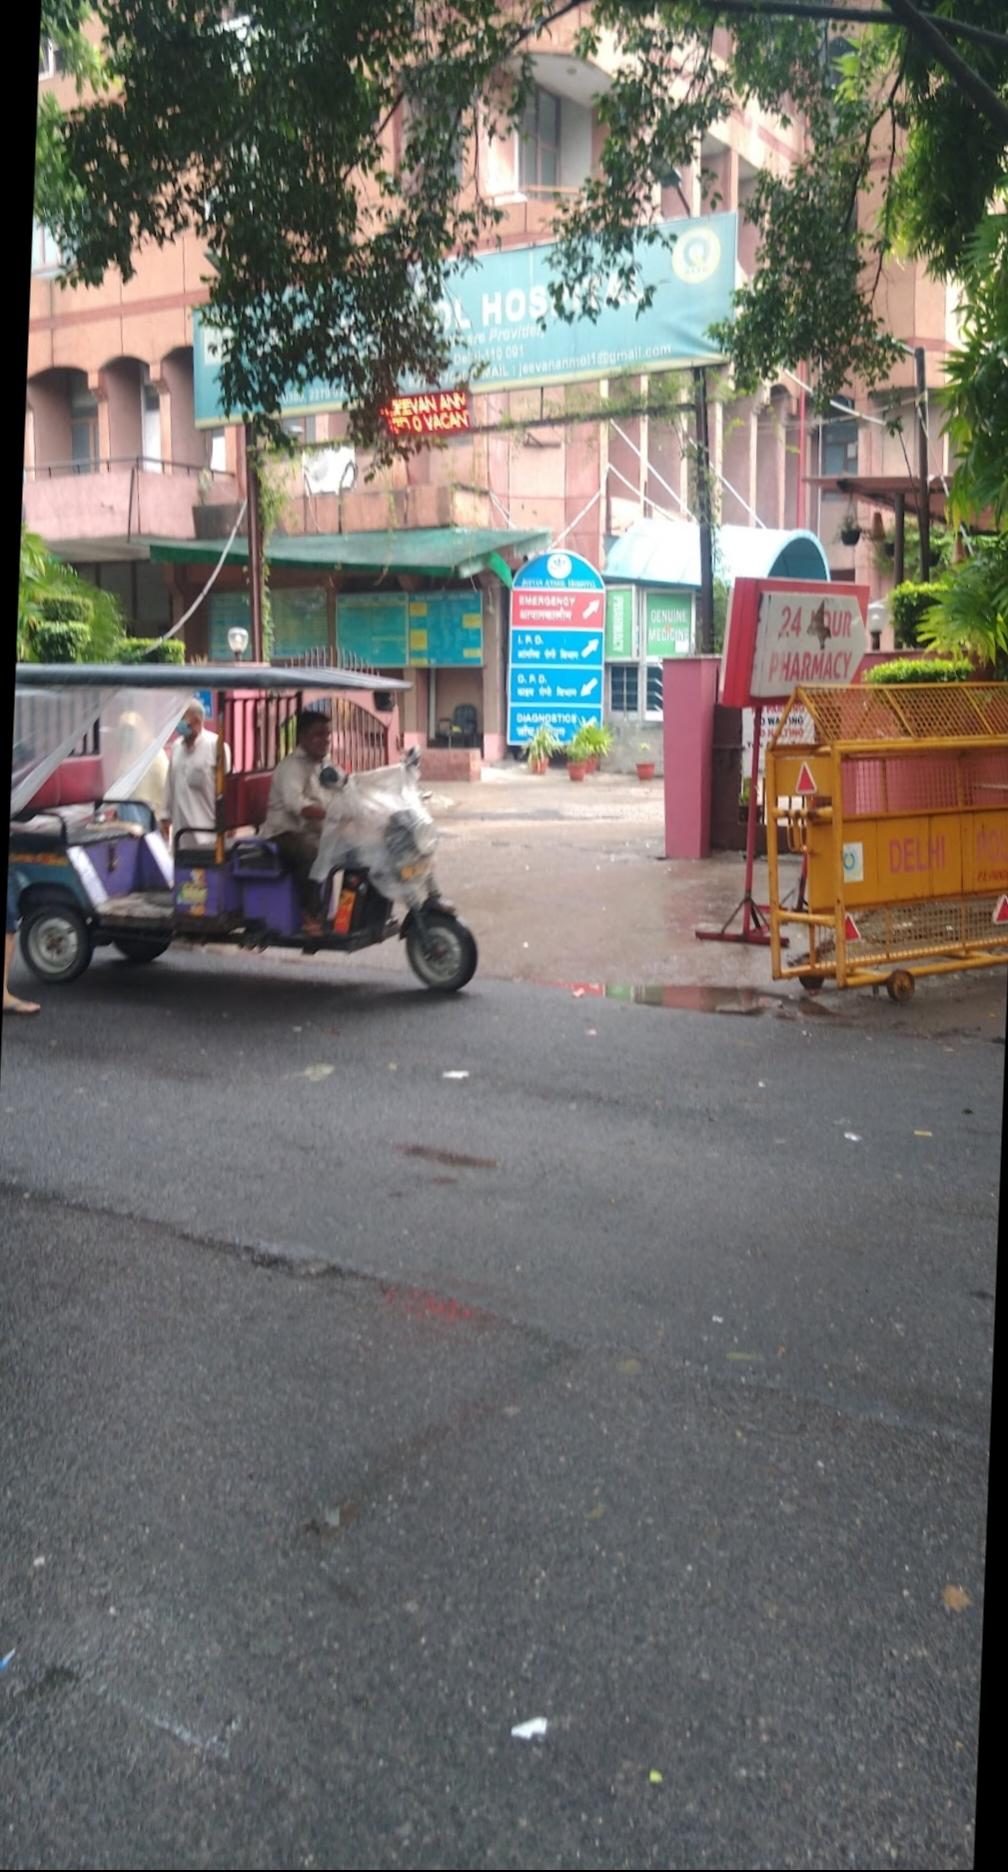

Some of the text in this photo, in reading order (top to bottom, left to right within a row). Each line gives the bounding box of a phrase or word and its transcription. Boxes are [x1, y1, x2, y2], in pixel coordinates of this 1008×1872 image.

[518, 594, 576, 607] EMERGENCY
[650, 608, 687, 624] GENUINE
[780, 605, 802, 638] 24
[768, 650, 853, 683] PHARMACY
[516, 712, 578, 725] DIAGNOSTICS
[889, 833, 946, 875] DELHI
